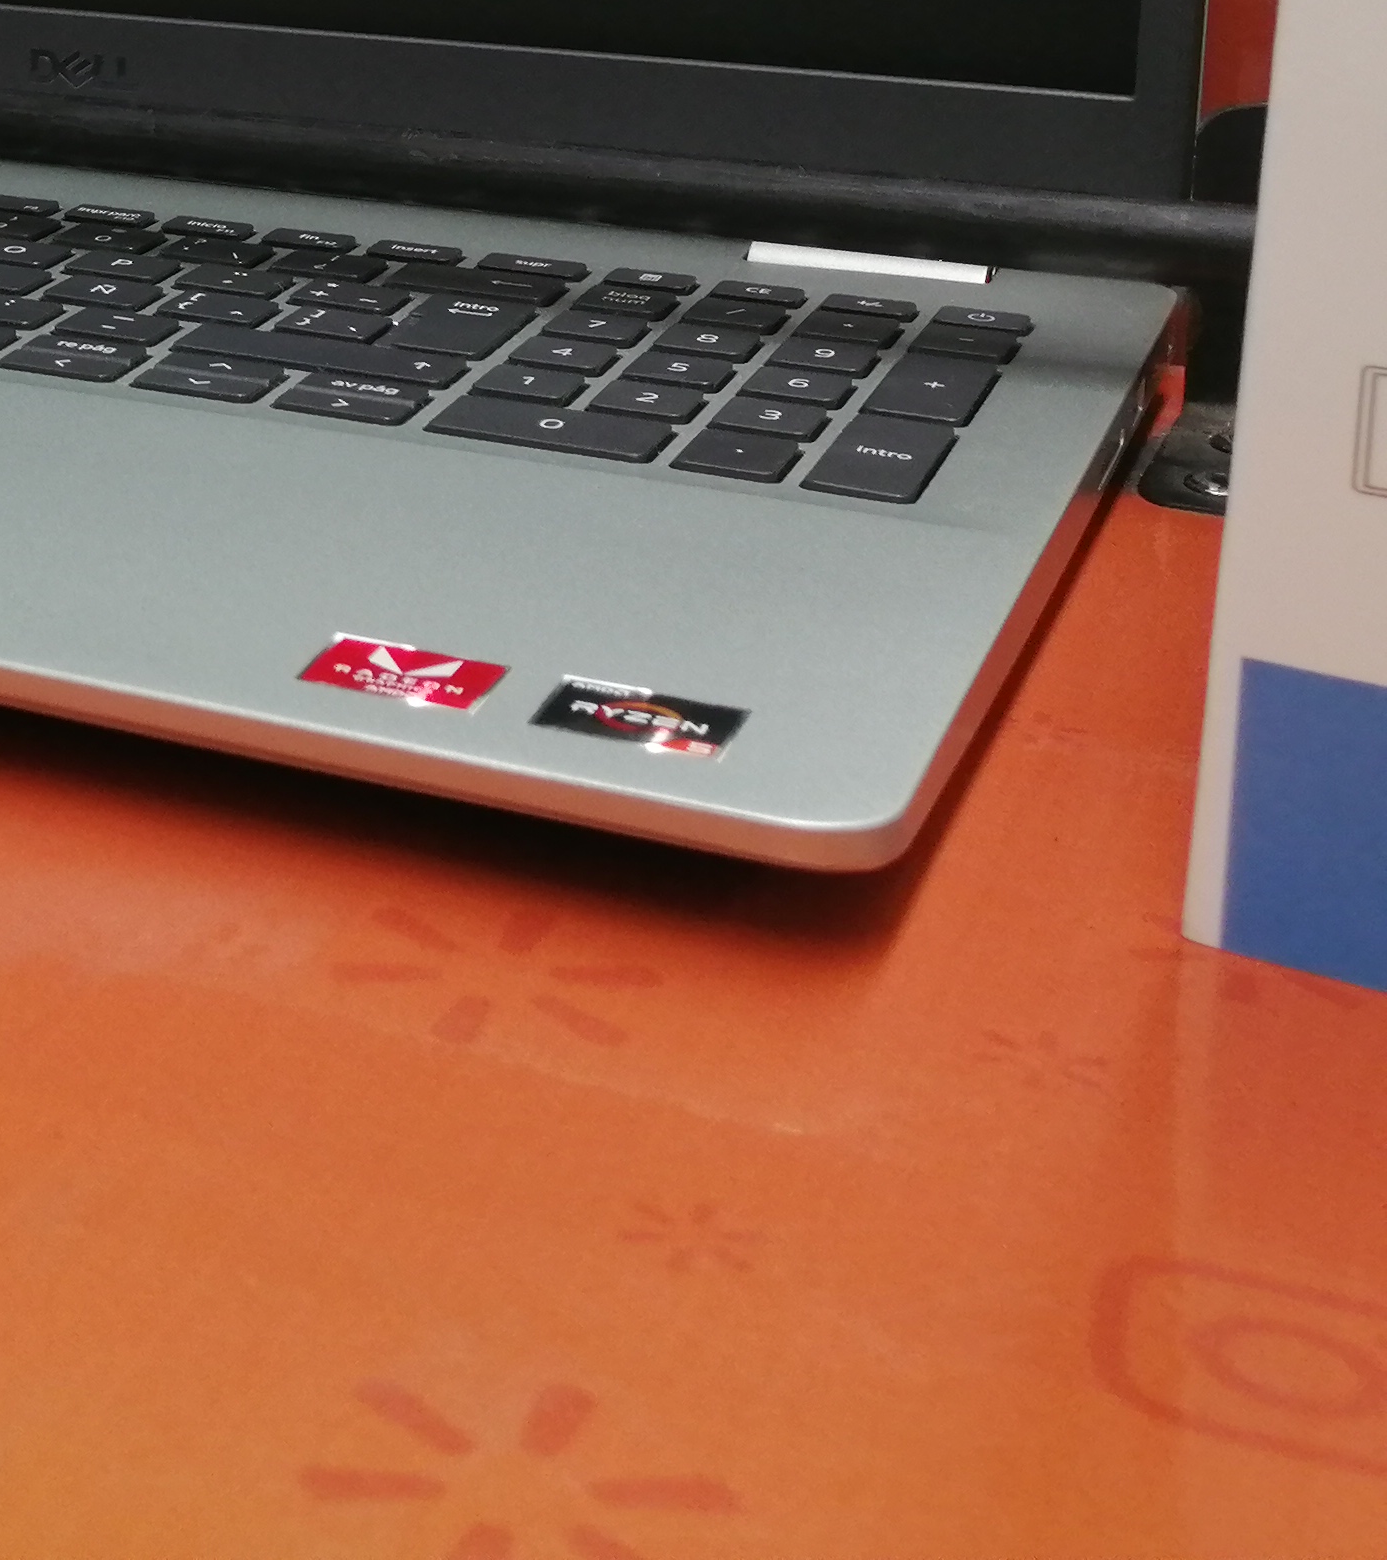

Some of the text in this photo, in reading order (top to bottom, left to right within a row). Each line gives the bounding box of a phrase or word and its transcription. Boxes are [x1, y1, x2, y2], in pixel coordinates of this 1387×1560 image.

[391, 244, 438, 254] insert
[515, 259, 552, 268] supr
[551, 347, 573, 356] 4
[814, 348, 836, 358] 9
[666, 362, 690, 372] 5
[787, 378, 810, 388] 6
[635, 392, 659, 404] 2
[758, 409, 783, 421] 3
[570, 700, 710, 736] RYZEN
